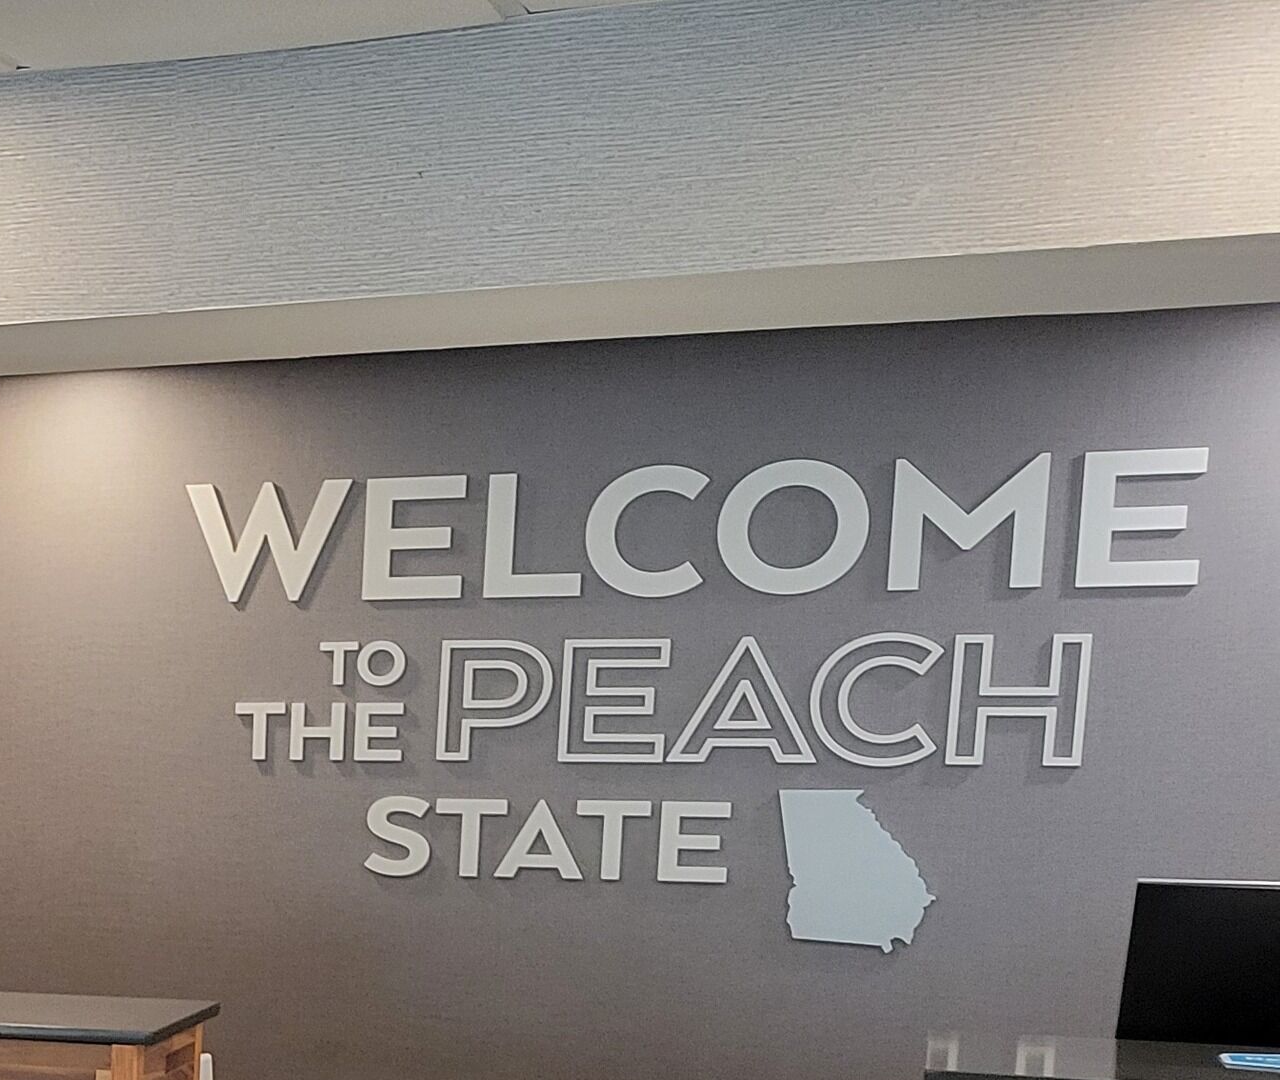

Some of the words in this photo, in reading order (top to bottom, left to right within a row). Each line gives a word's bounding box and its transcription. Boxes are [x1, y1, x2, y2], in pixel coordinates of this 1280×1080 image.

[185, 447, 1209, 603] WELCOME
[235, 702, 405, 763] THE
[436, 632, 1093, 768] PEACH
[320, 640, 407, 688] TO
[362, 795, 732, 884] STATE
